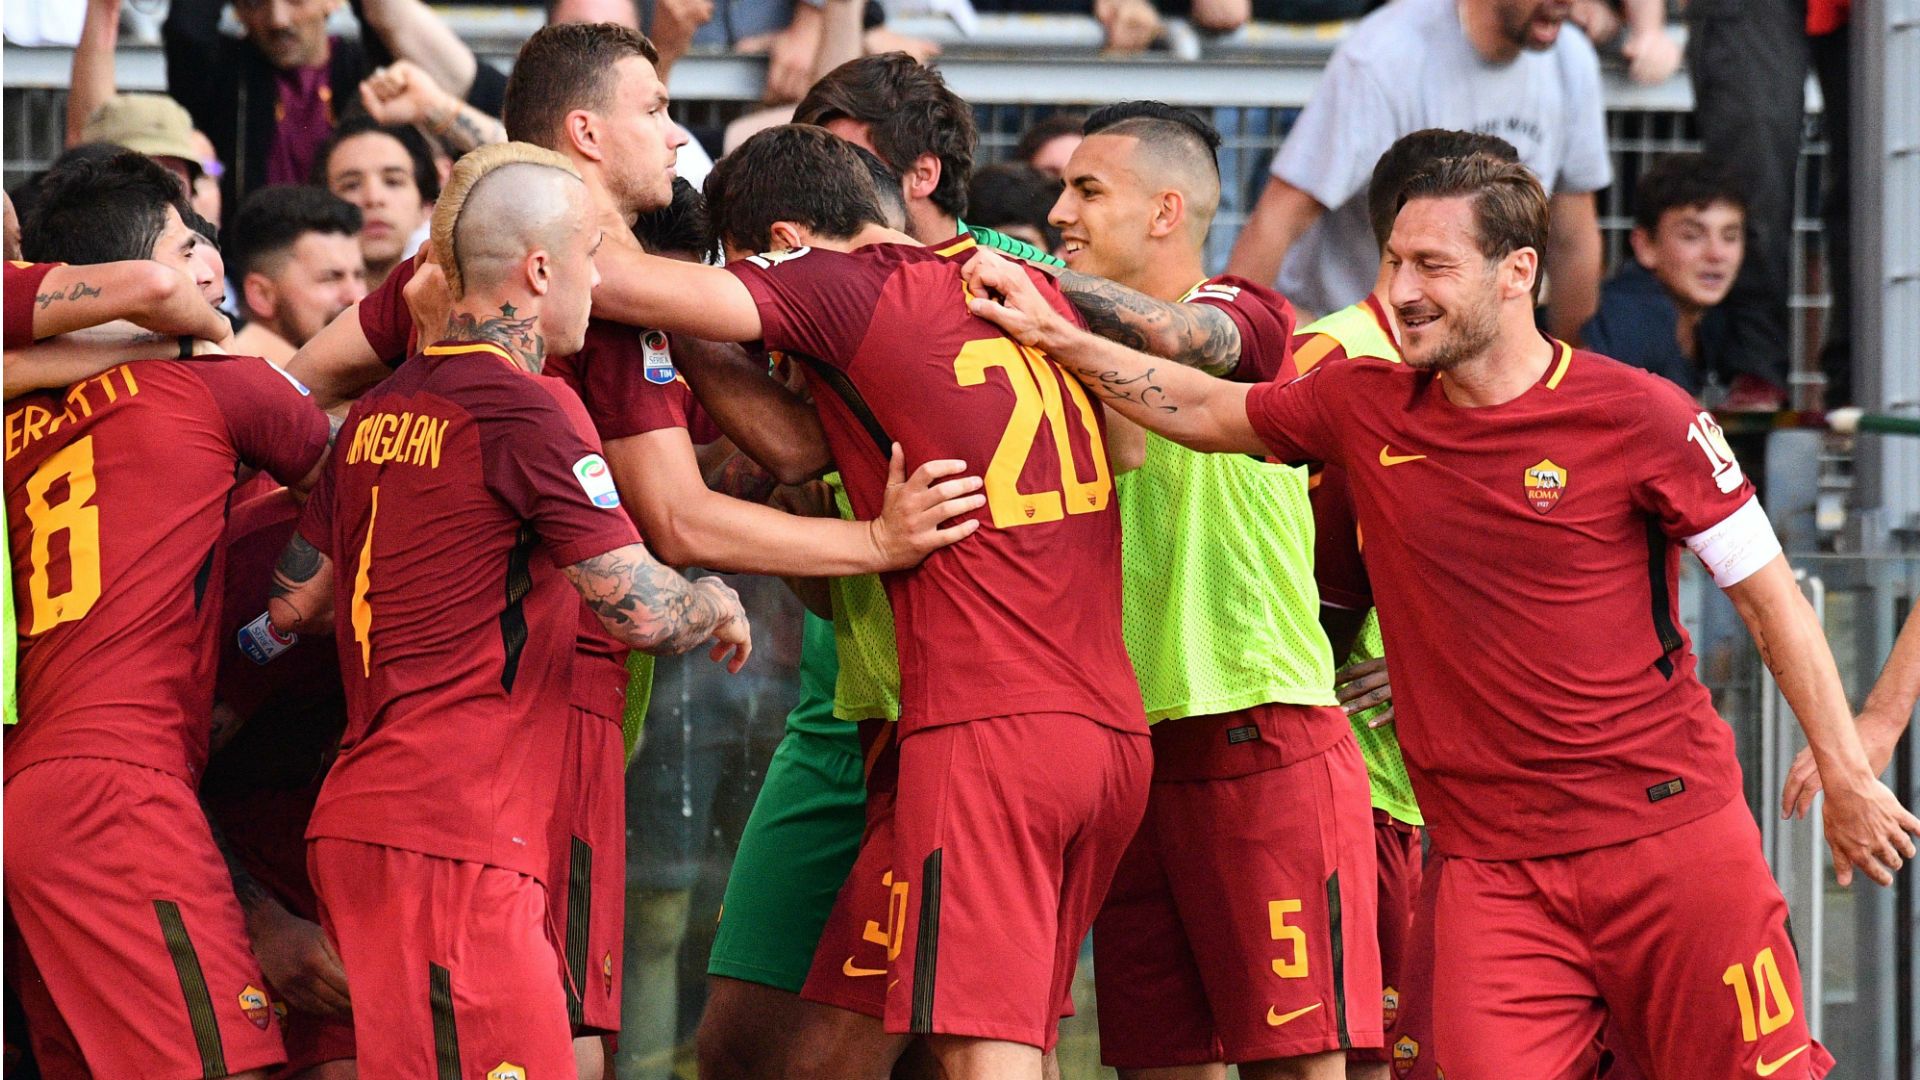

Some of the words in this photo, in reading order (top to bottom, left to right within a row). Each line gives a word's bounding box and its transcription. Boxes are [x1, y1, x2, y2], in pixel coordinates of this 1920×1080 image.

[953, 336, 1112, 529] 20
[25, 434, 101, 636] 8
[1528, 490, 1559, 500] ROMA
[1268, 898, 1309, 978] 5
[1722, 946, 1795, 1042] 10
